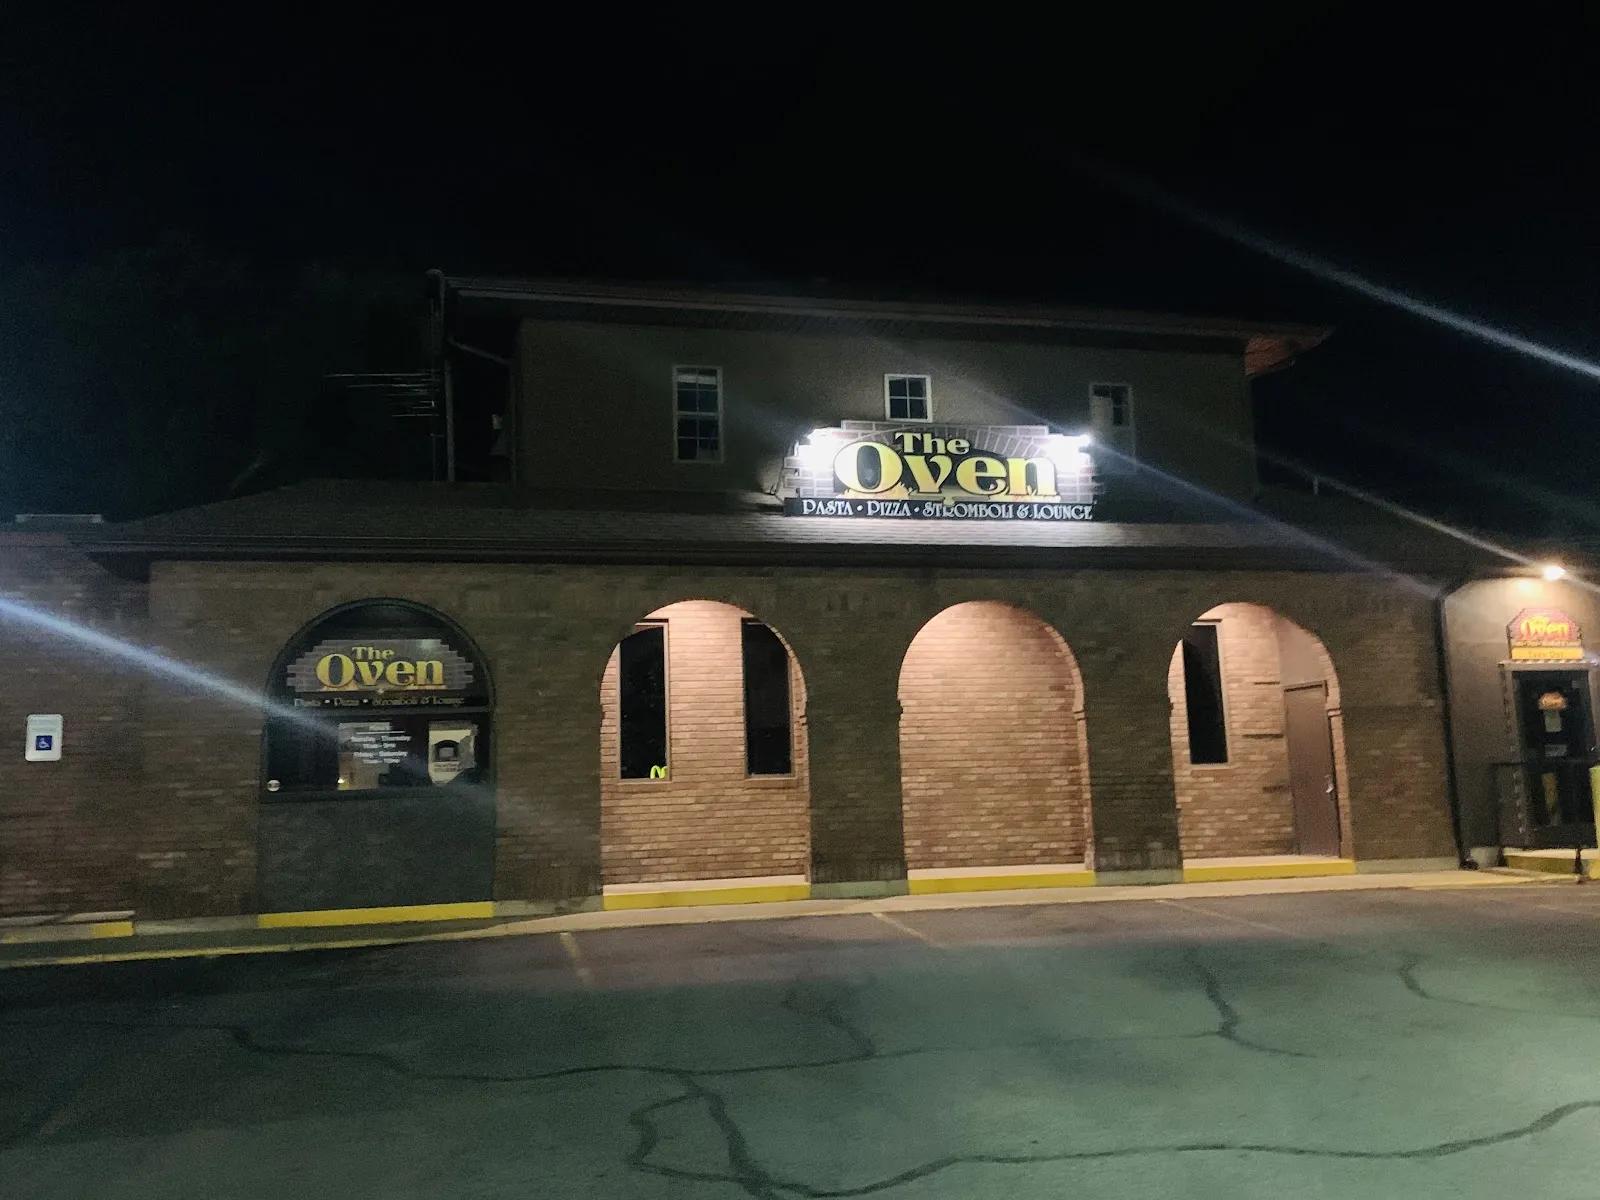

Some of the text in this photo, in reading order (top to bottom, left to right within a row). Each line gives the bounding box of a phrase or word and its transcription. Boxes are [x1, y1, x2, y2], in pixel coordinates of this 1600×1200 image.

[895, 432, 970, 455] The
[833, 441, 1058, 497] Oven
[801, 498, 854, 516] PASTA
[866, 500, 912, 517] PIZZA
[1016, 504, 1031, 519] &
[1031, 505, 1093, 520] LOUNGE
[352, 646, 395, 661] The
[316, 653, 444, 687] Oven
